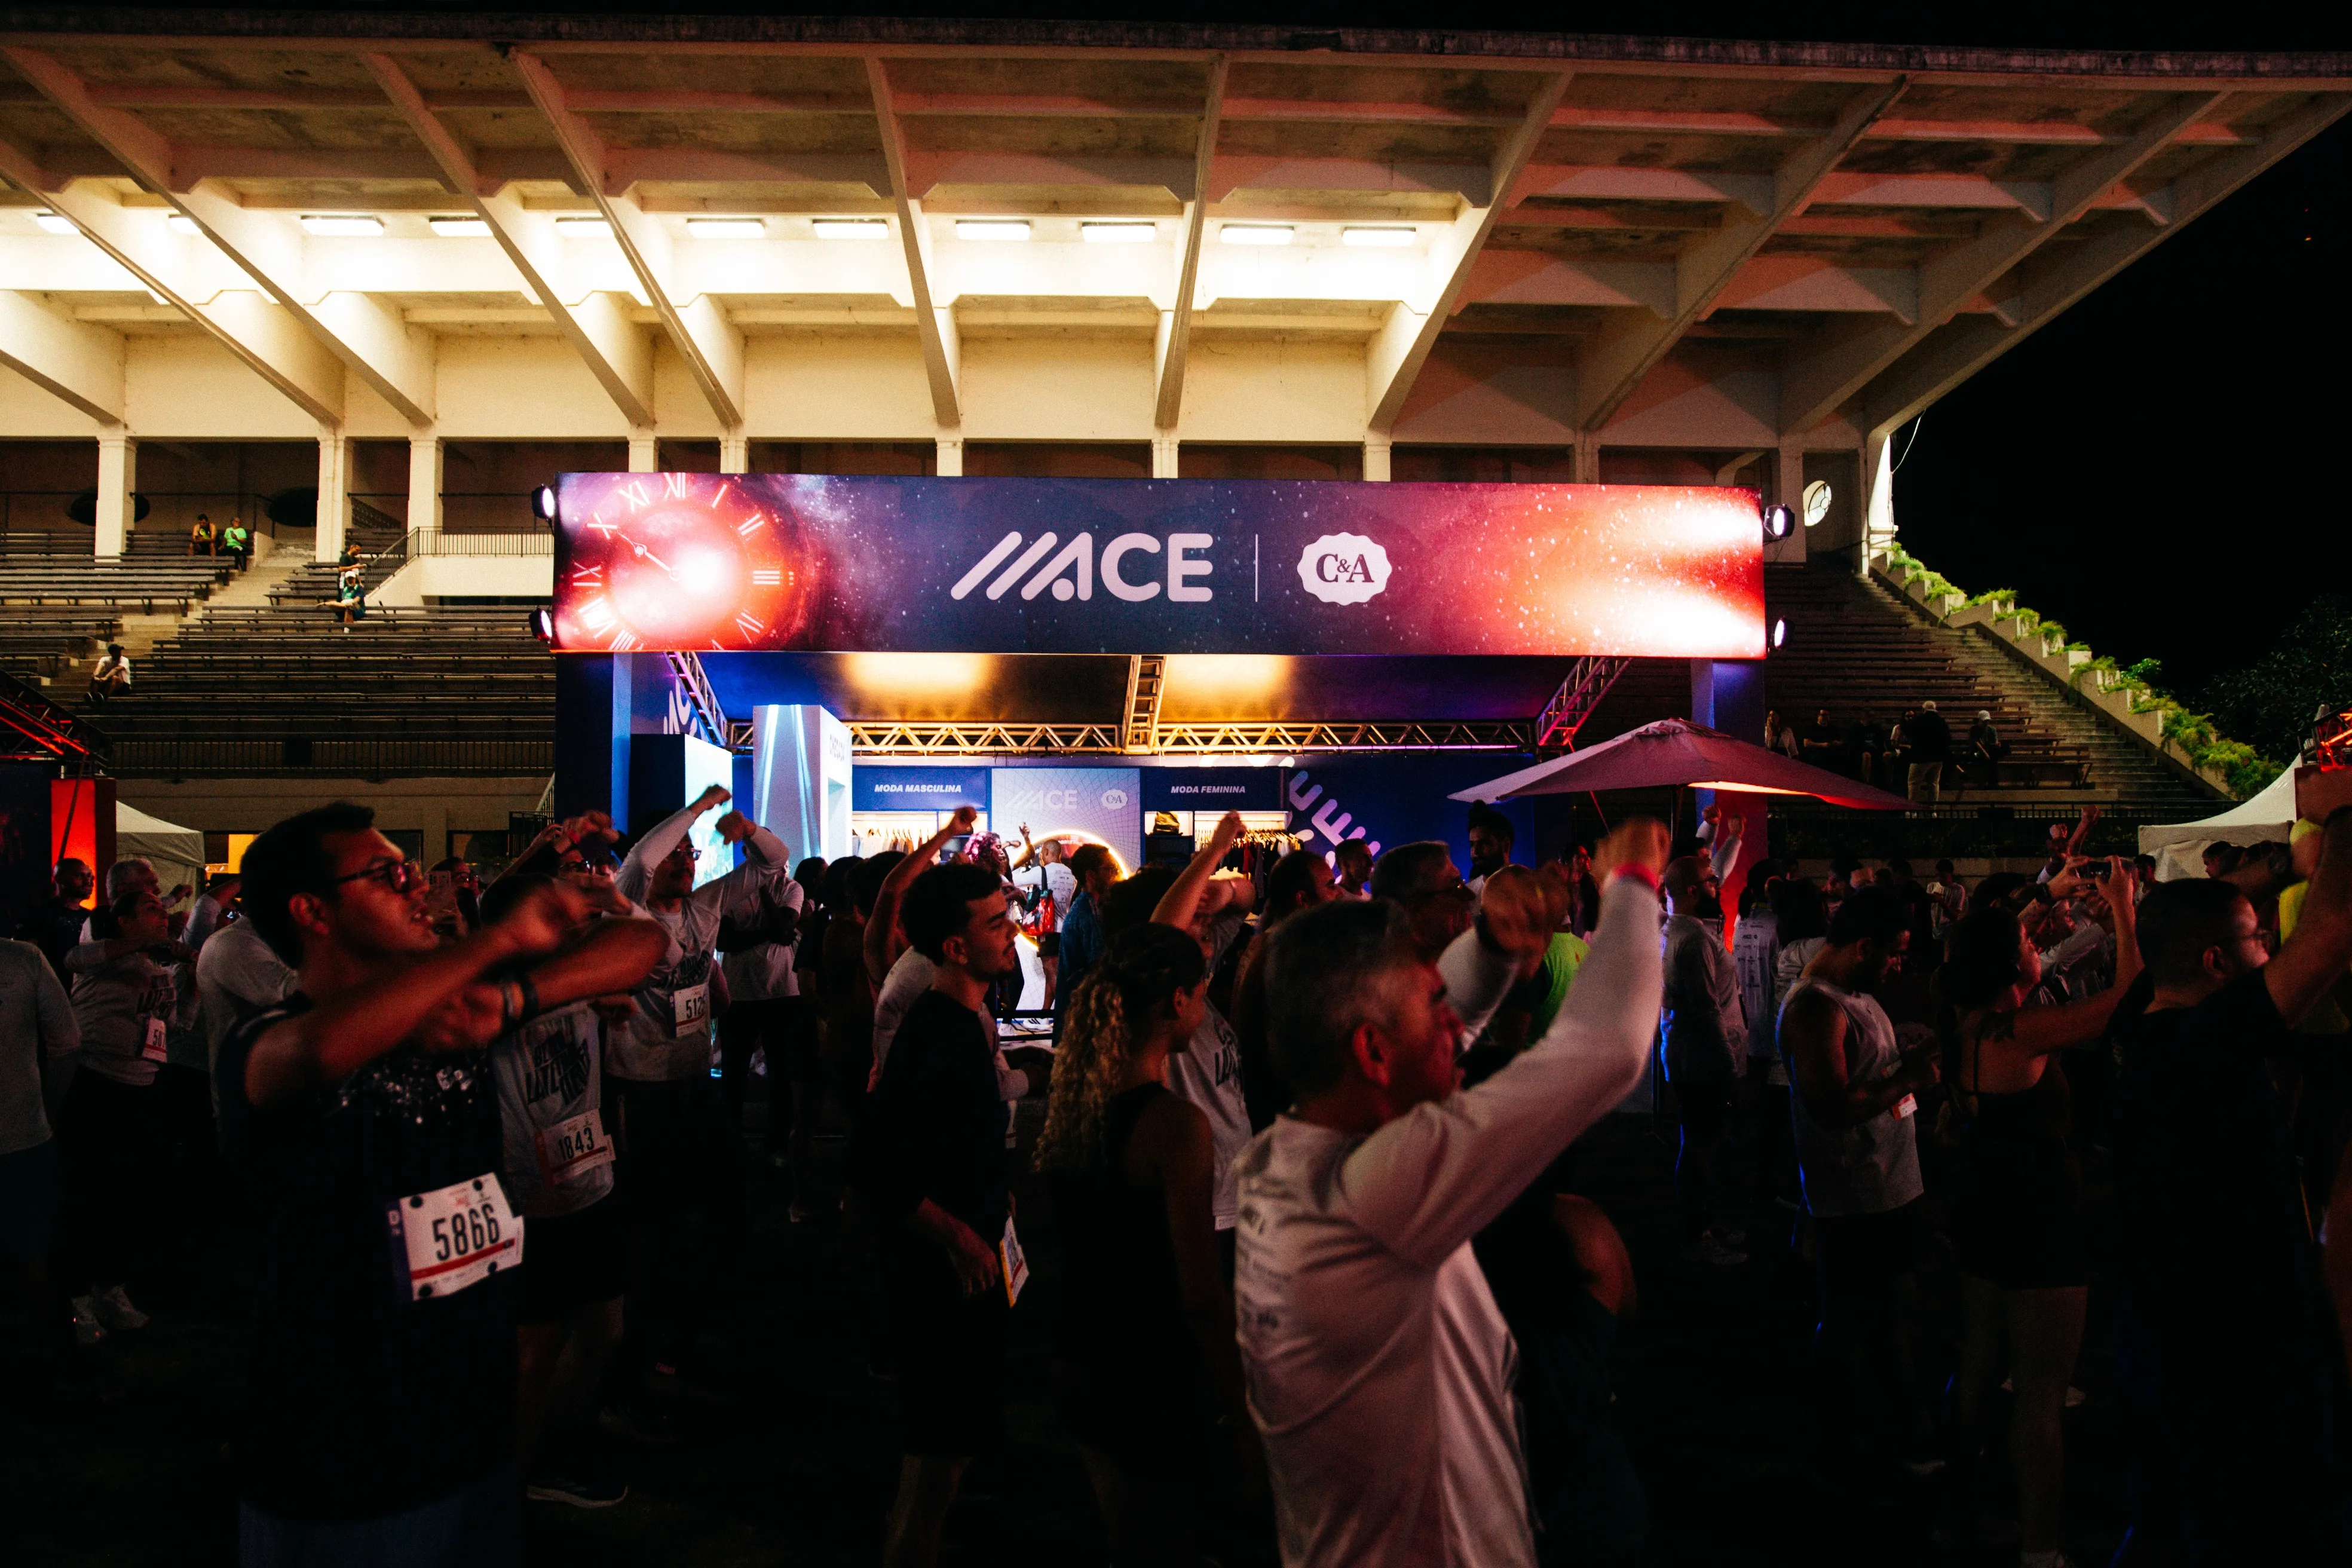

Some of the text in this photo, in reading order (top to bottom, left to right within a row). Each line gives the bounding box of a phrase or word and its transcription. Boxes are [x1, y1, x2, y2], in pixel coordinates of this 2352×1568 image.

[1316, 553, 1374, 583] C&A
[874, 784, 961, 792] MODA MASCULINA
[559, 1127, 594, 1161] 1843
[432, 1203, 500, 1261] 5866
